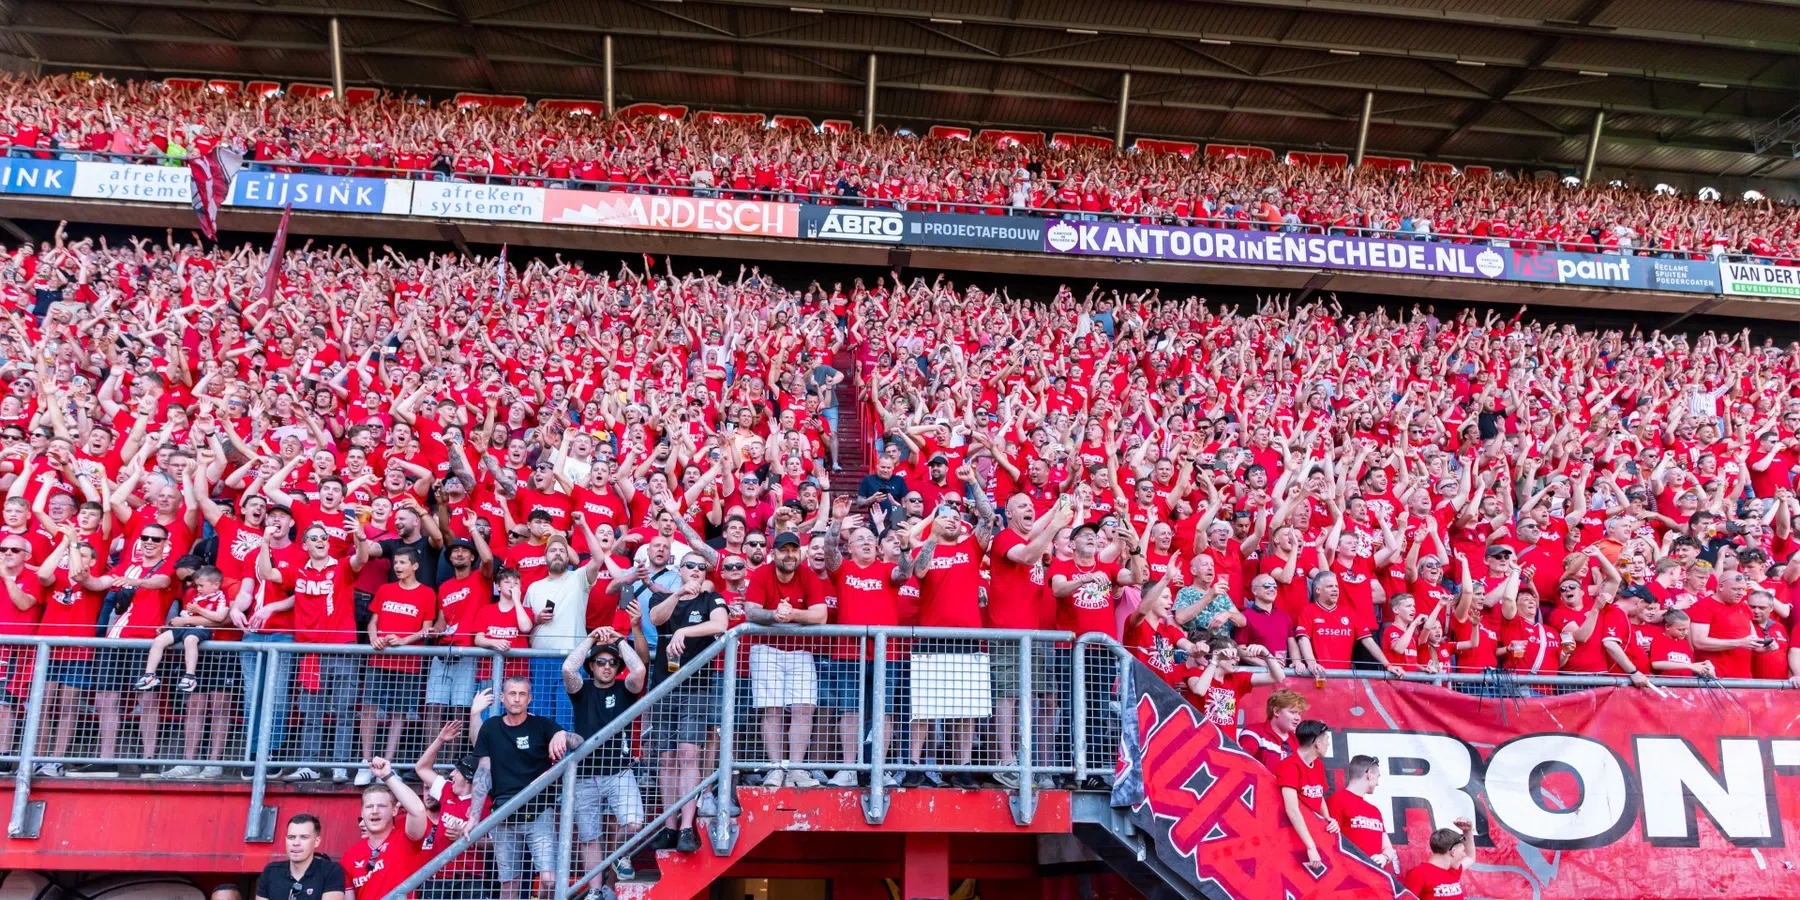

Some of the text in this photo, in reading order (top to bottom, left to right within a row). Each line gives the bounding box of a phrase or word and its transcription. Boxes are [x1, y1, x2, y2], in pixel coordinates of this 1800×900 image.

[97, 184, 188, 198] systeme
[442, 189, 523, 201] afreken
[431, 201, 532, 216] systemen
[630, 197, 783, 233] ARDESCH
[821, 214, 903, 236] ABRO
[924, 223, 1040, 241] PROJECTAFBOUW
[1558, 258, 1630, 283] paint
[1655, 263, 1688, 272] RECLAME
[1730, 265, 1760, 282] VAN
[1765, 268, 1793, 284] DER
[1655, 271, 1687, 279] SPUITEN
[1656, 278, 1714, 287] POEDERCOATEN
[295, 579, 334, 595] SNS
[1074, 598, 1109, 609] EUROPA
[1318, 627, 1352, 637] essent
